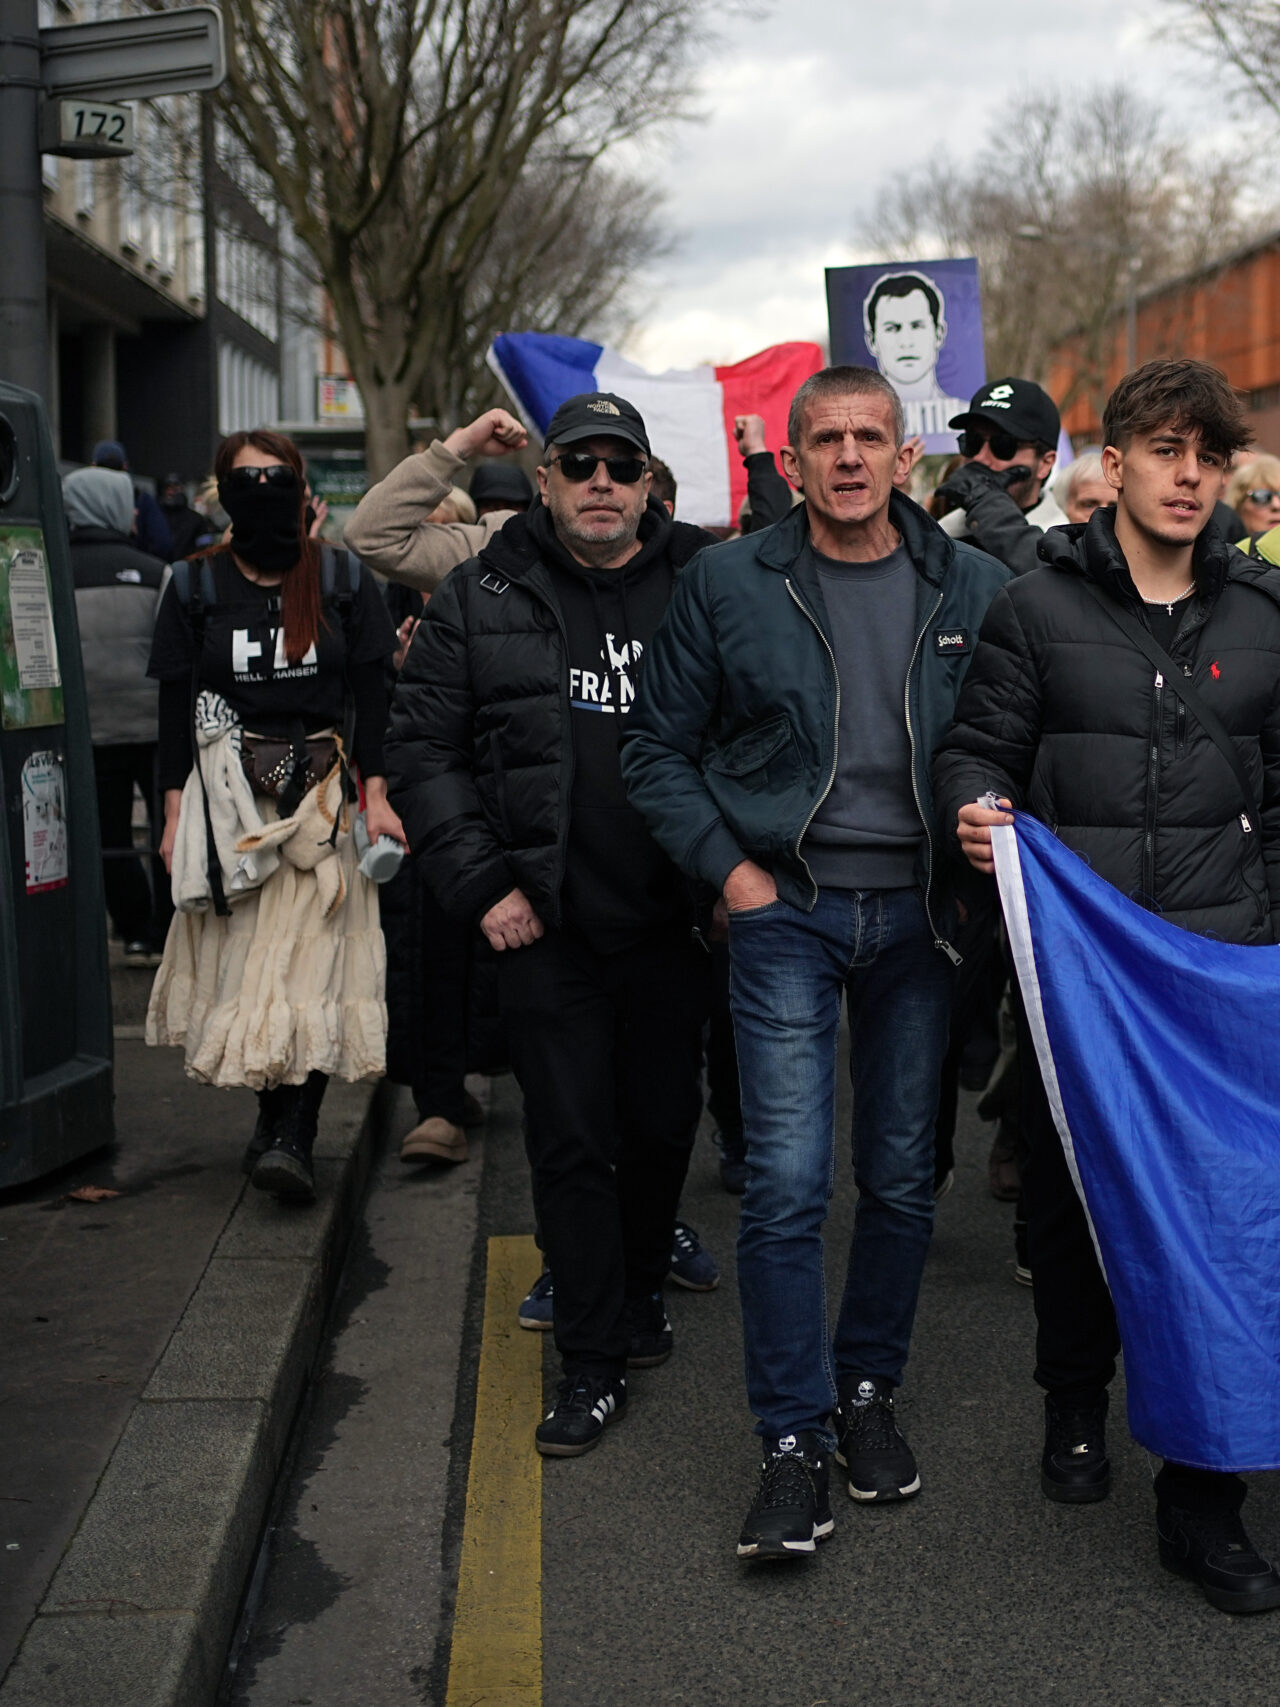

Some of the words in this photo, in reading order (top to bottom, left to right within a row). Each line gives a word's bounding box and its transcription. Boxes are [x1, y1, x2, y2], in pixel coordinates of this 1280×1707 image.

[75, 110, 125, 144] 172
[938, 634, 963, 647] Schott
[234, 672, 267, 683] HELL
